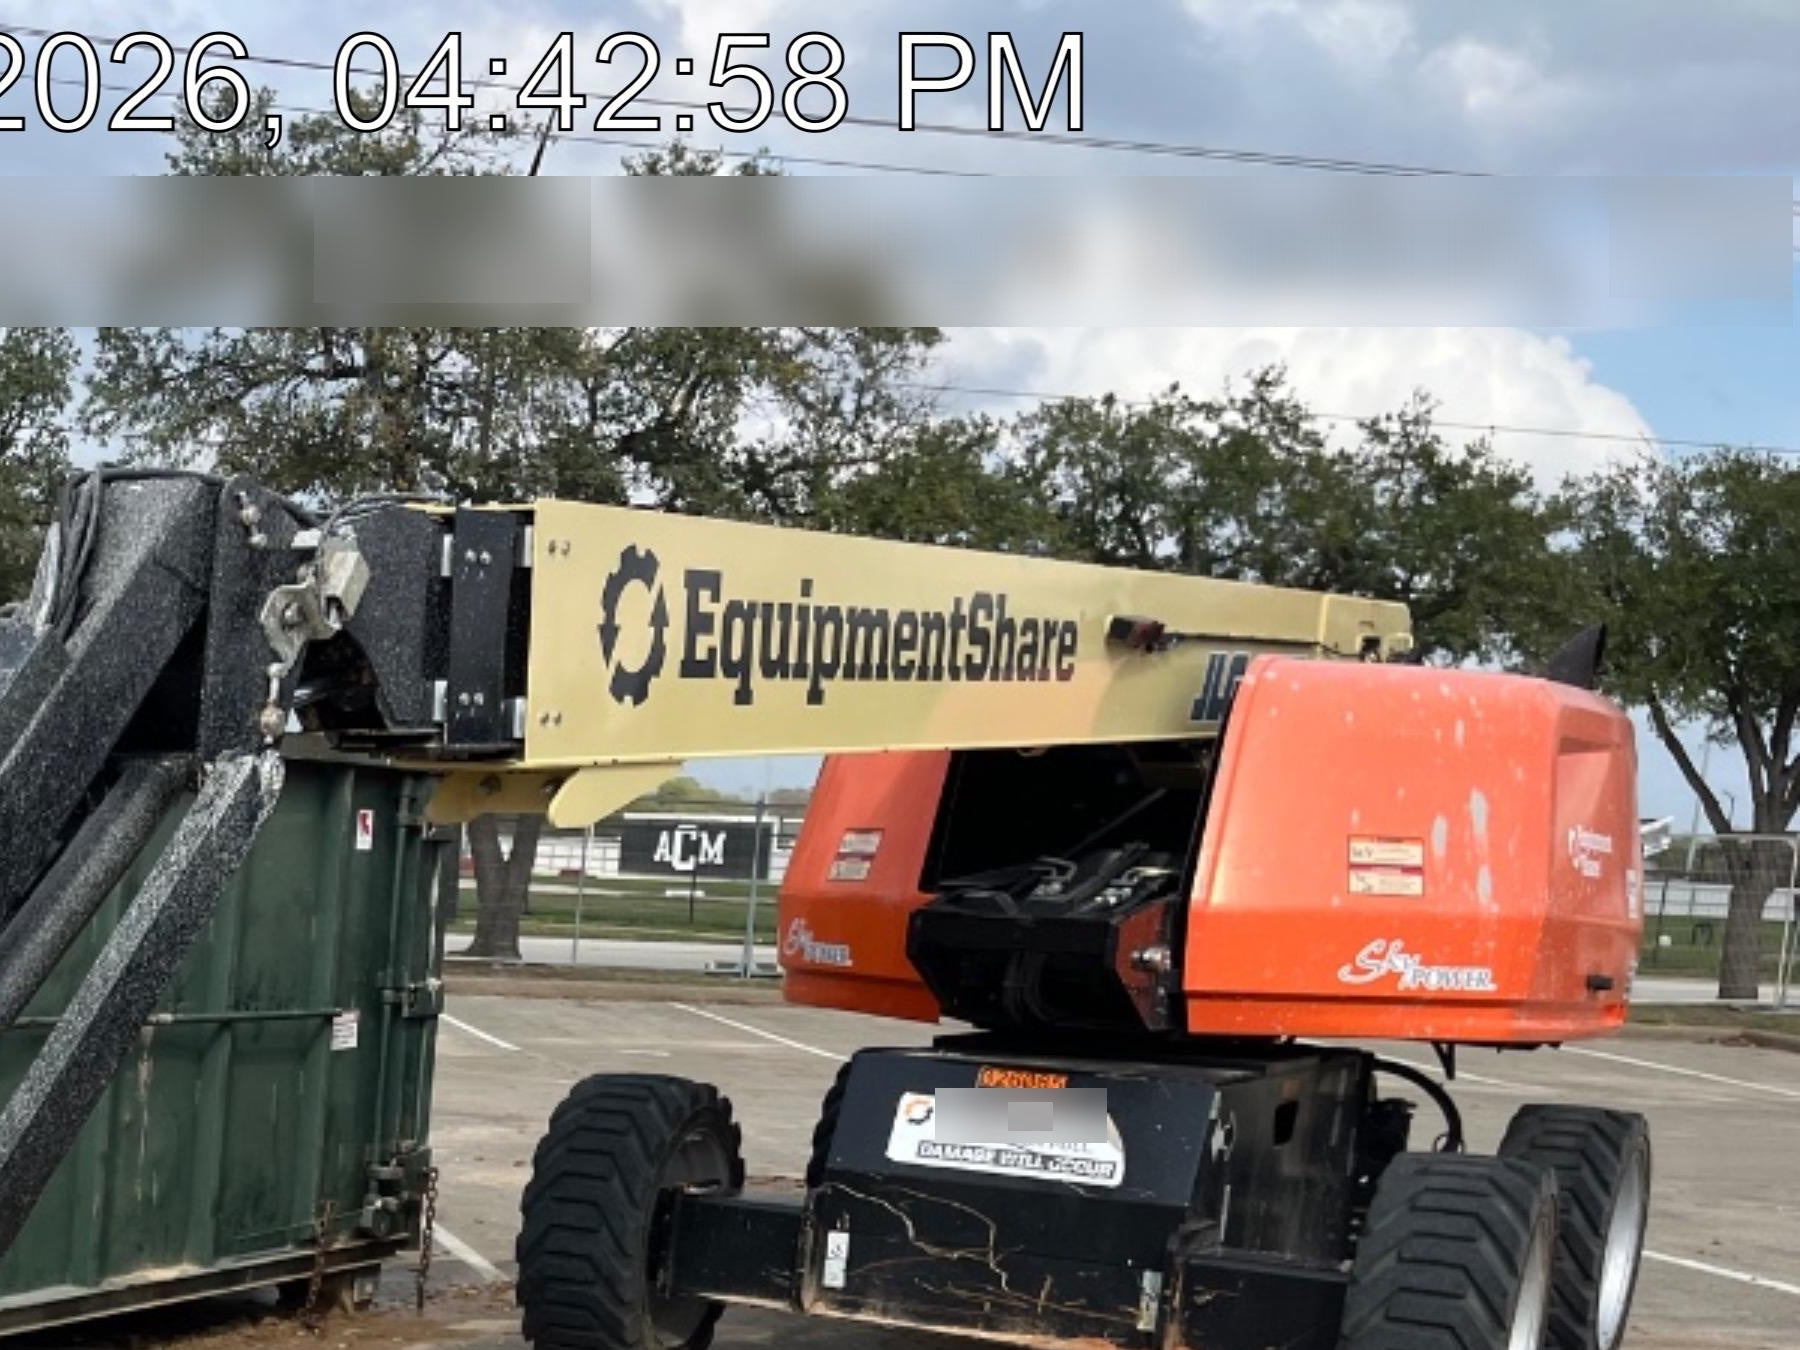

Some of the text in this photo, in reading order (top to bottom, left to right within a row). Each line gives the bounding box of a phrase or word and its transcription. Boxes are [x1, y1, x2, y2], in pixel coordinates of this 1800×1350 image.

[679, 569, 1078, 705] EquipmentShare
[653, 824, 727, 870] ACM
[1000, 1149, 1044, 1169] WILL
